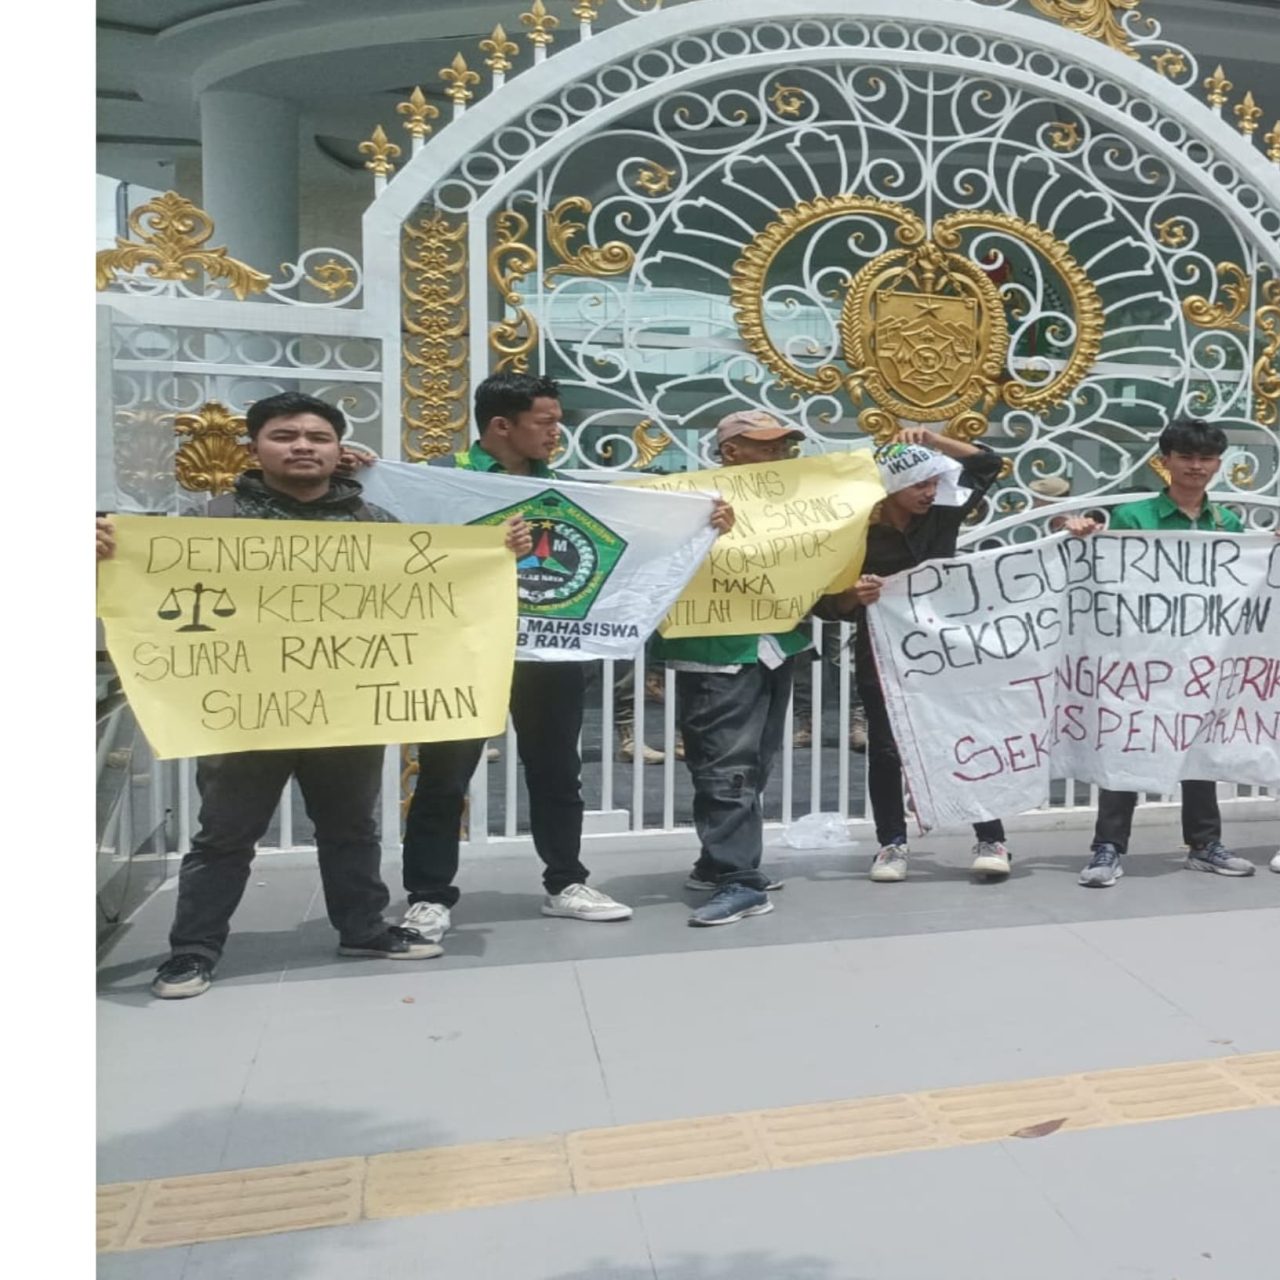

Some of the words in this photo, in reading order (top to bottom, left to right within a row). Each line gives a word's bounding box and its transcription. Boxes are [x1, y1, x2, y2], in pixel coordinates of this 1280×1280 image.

[713, 470, 786, 502] DINAS
[763, 494, 856, 533] SARANG
[146, 533, 372, 575] DENGARKAN
[404, 530, 449, 575] &
[553, 540, 568, 552] M
[710, 529, 838, 576] KORUPTOR
[257, 581, 458, 623] KERJAKAN
[712, 573, 776, 595] MAKA
[527, 619, 639, 638] MAHASISWA
[536, 634, 581, 649] RAYA
[901, 607, 1063, 678] SEKDIS
[1067, 586, 1272, 638] PENDIDIKAN
[132, 640, 252, 682] SUARA
[281, 632, 419, 673] RAKYAT
[201, 688, 329, 731] SUARA
[355, 681, 479, 727] TUHAN
[1009, 654, 1174, 719] TNGKAP
[952, 704, 1087, 782] SEKIS
